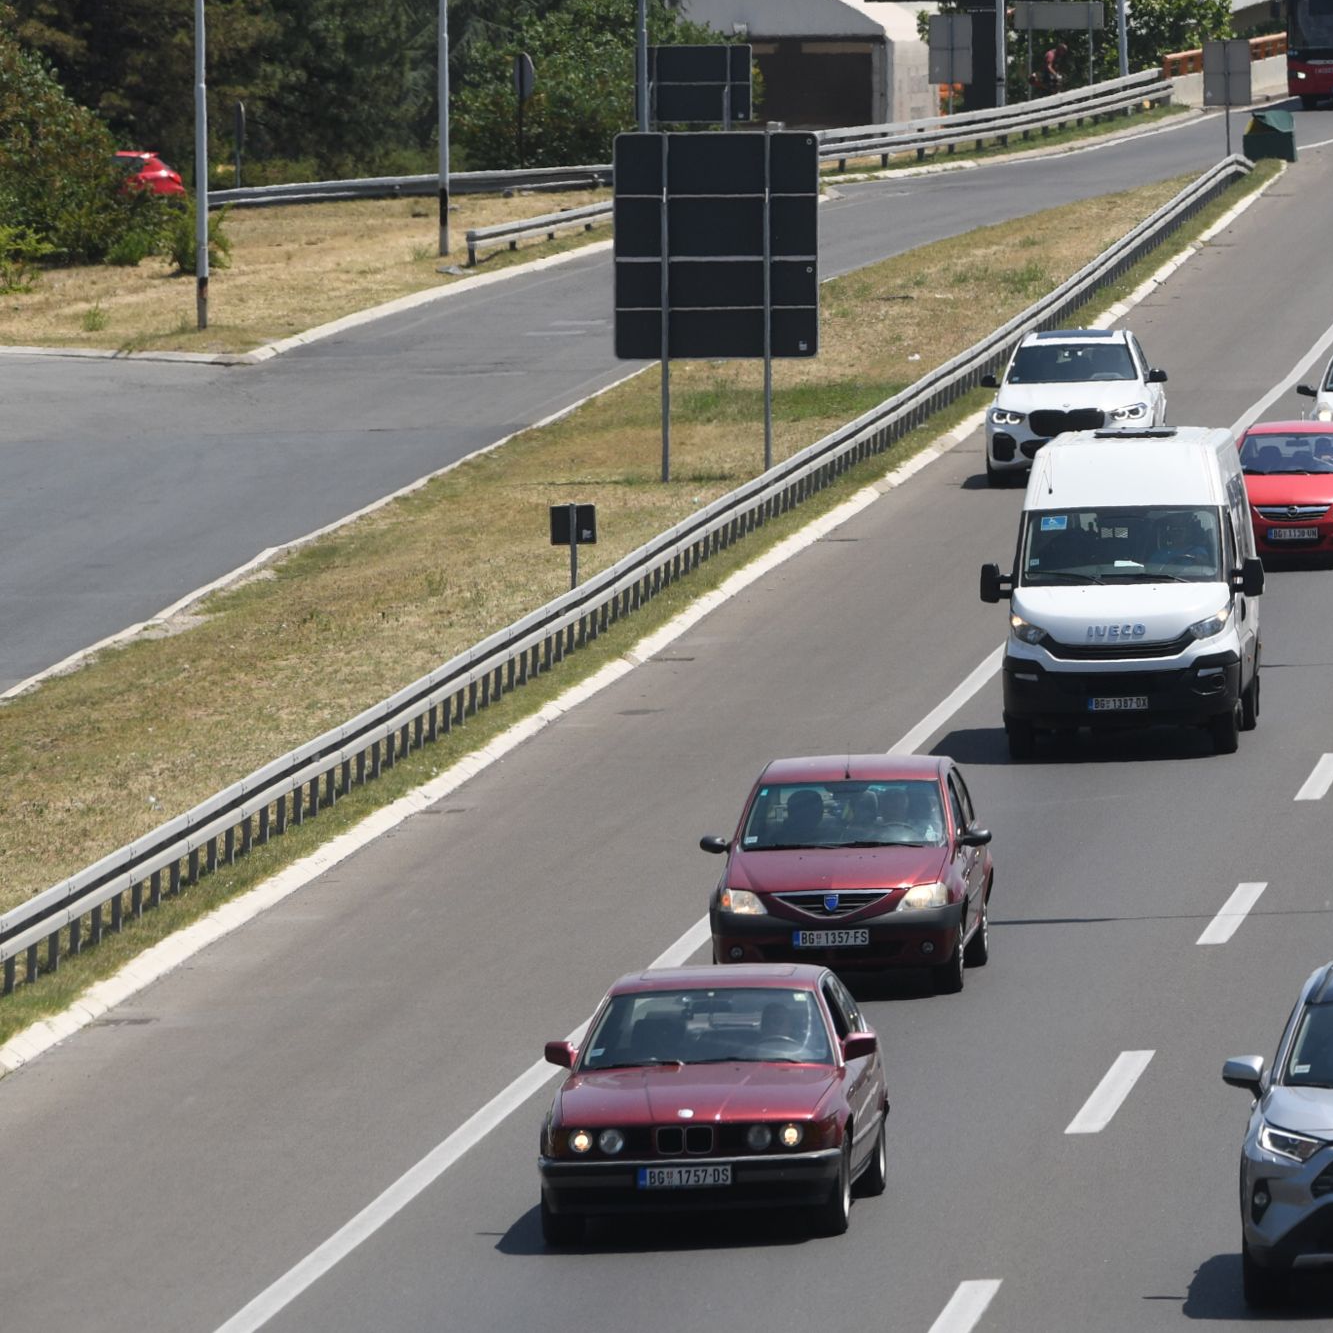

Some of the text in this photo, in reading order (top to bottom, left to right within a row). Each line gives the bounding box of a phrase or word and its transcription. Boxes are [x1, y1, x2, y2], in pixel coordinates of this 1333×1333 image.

[1087, 623, 1146, 637] IVECO
[1094, 699, 1105, 708] BG
[801, 931, 815, 945] BG
[649, 1169, 665, 1185] BG
